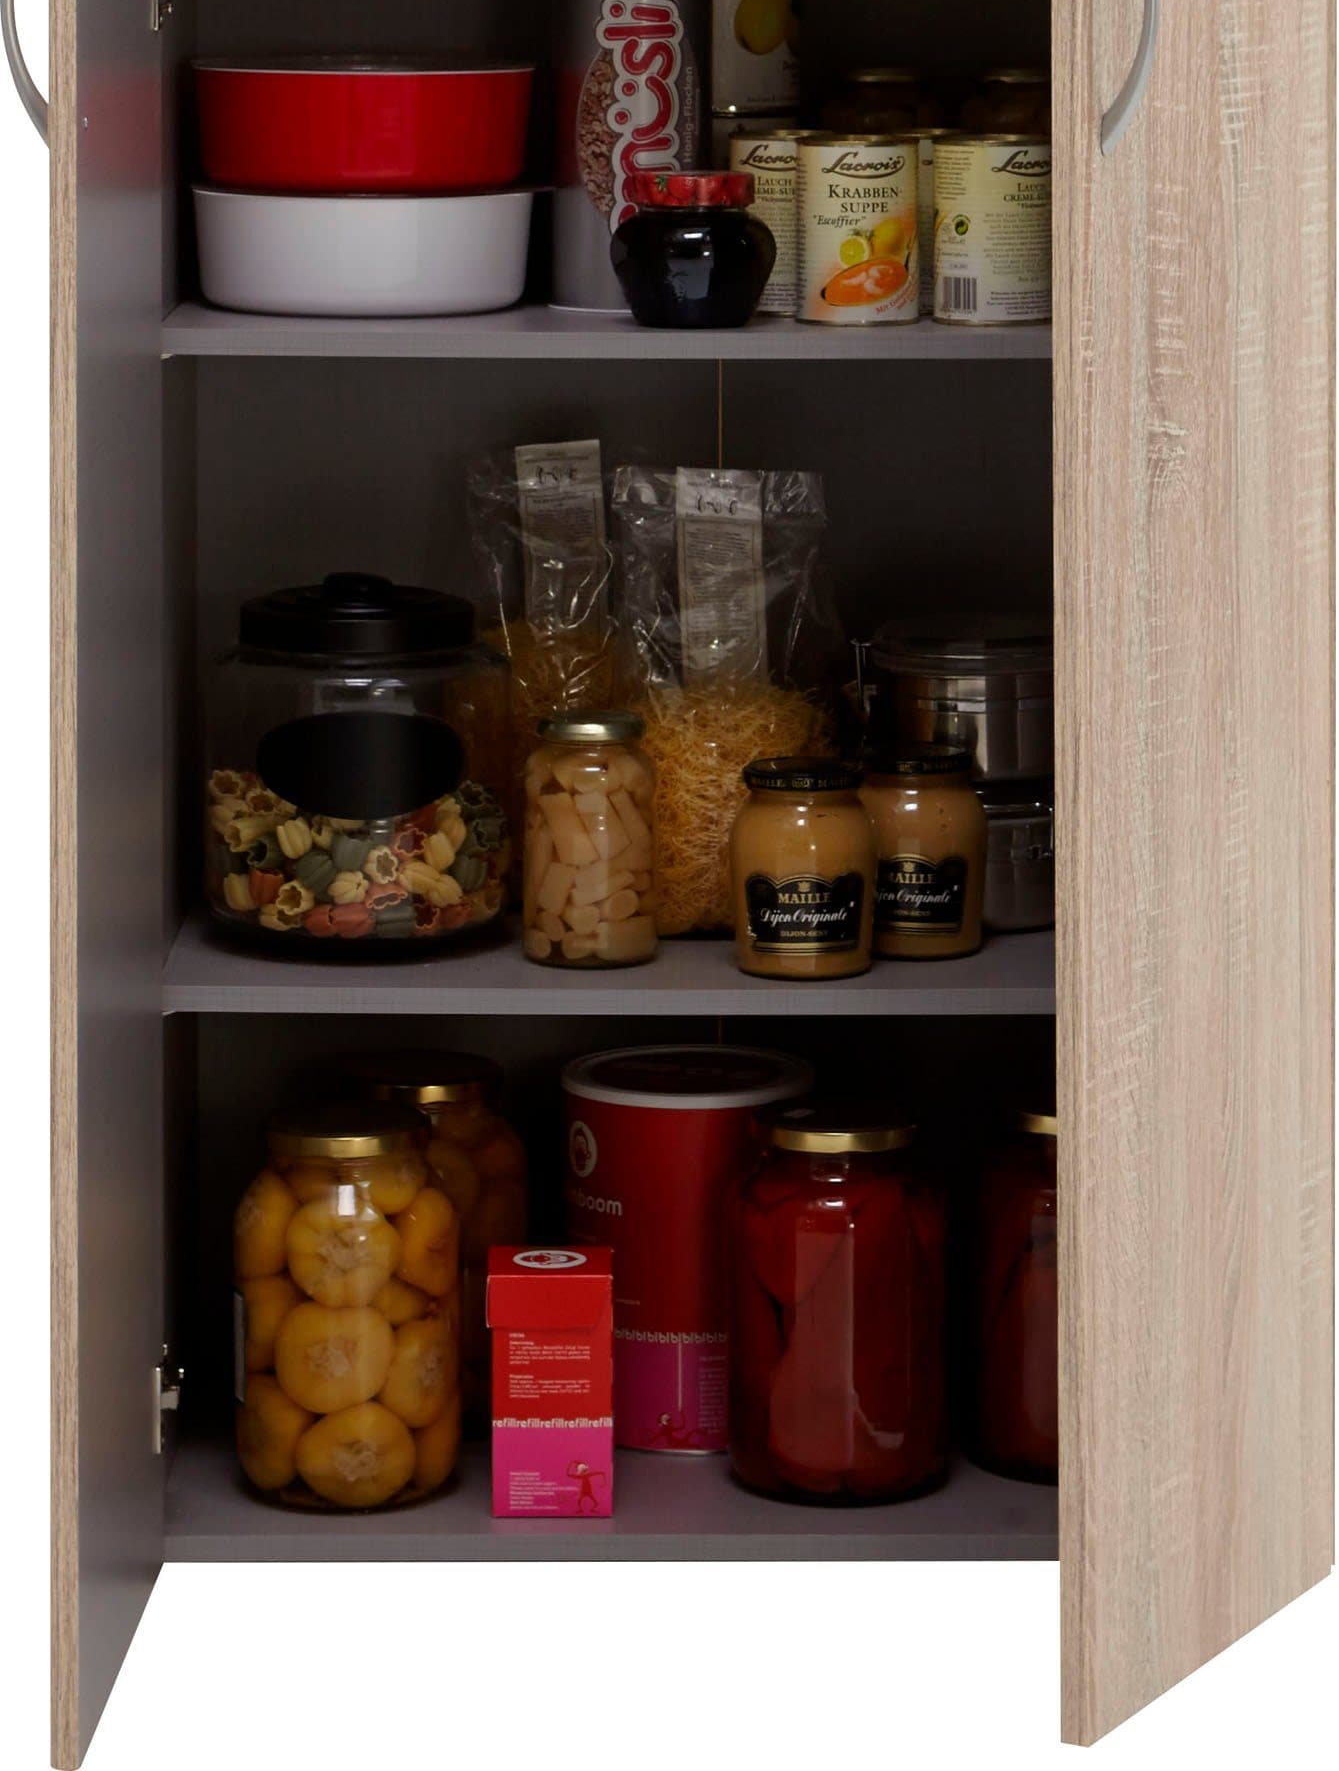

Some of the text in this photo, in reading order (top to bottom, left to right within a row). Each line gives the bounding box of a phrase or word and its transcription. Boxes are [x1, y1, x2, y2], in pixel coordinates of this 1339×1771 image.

[821, 151, 905, 178] Lacroix
[757, 176, 792, 186] LAUCH
[828, 184, 902, 198] KRABBEN-
[840, 202, 889, 213] SUPPE
[777, 892, 832, 904] MAILLE
[760, 908, 847, 928] Dijon Originale
